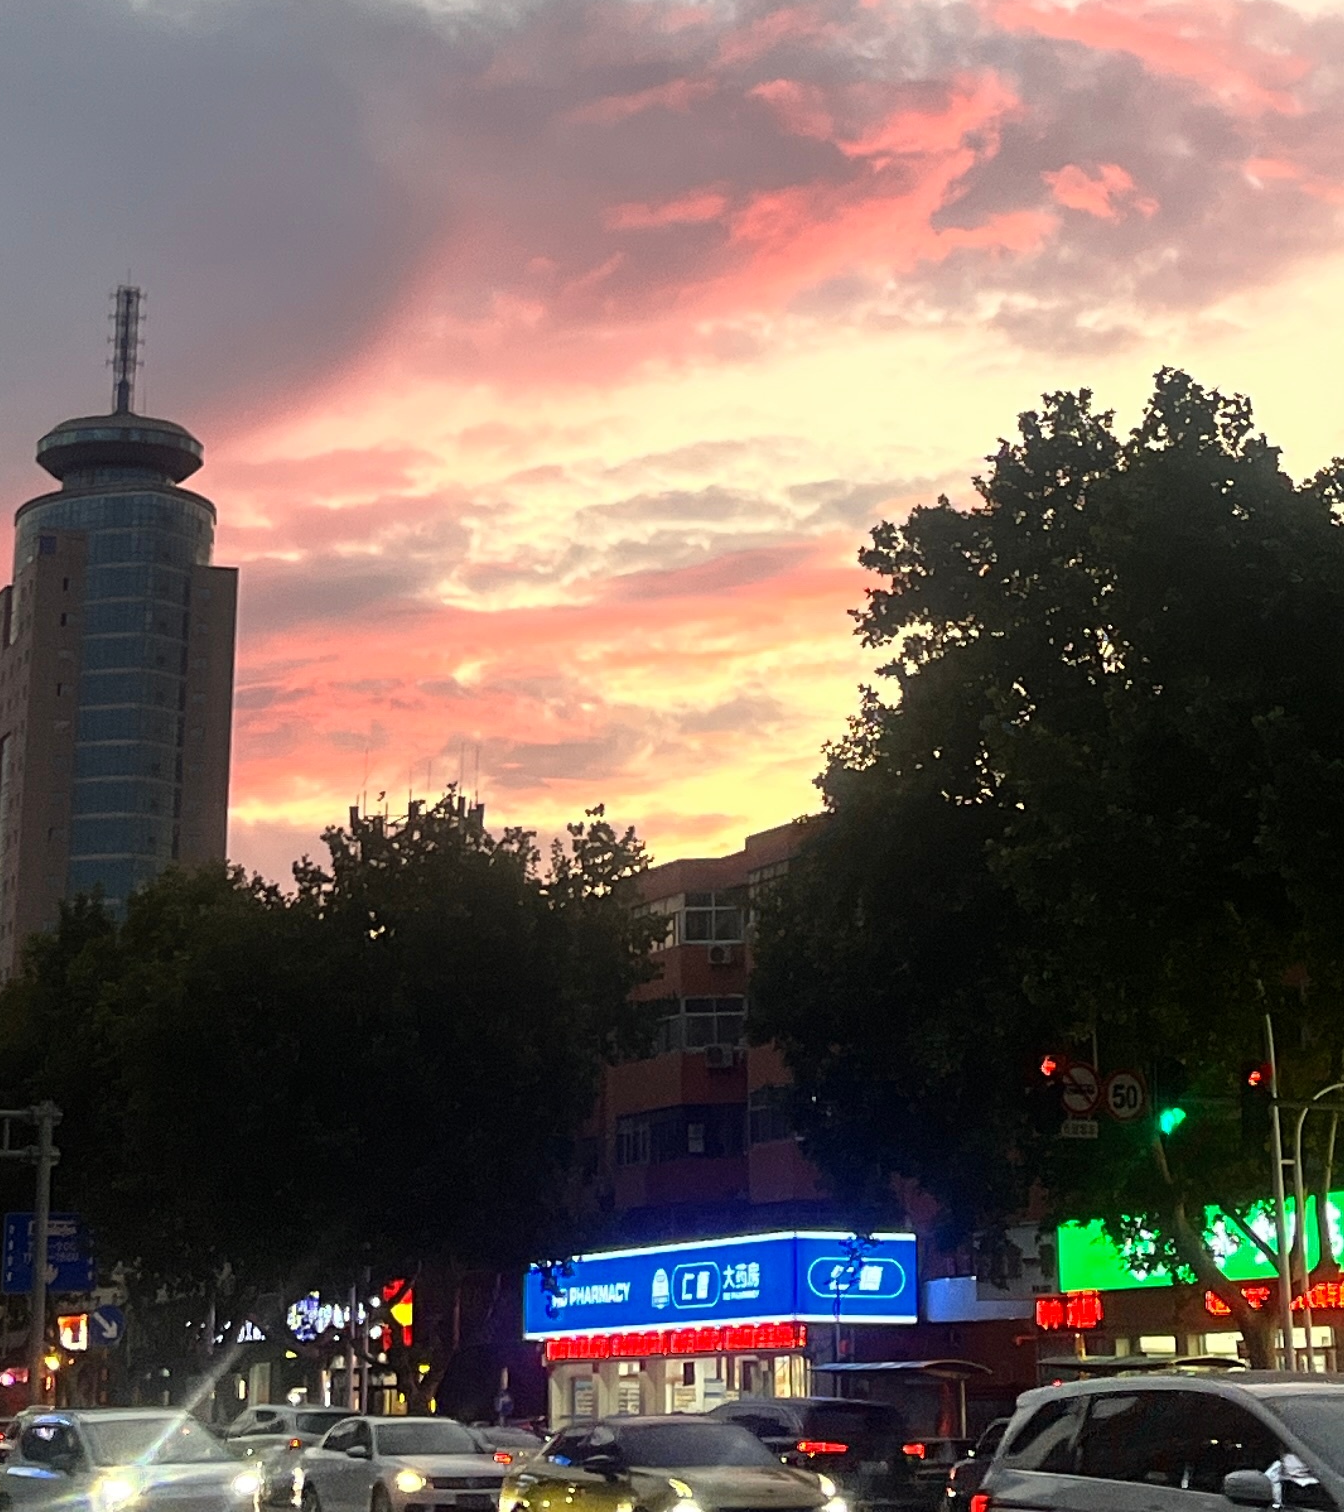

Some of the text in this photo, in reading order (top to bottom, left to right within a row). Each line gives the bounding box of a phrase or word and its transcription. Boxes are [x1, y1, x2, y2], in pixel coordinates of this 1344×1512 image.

[1113, 1084, 1137, 1109] 50
[722, 1261, 760, 1289] 大药房
[569, 1281, 631, 1306] PHARMACY
